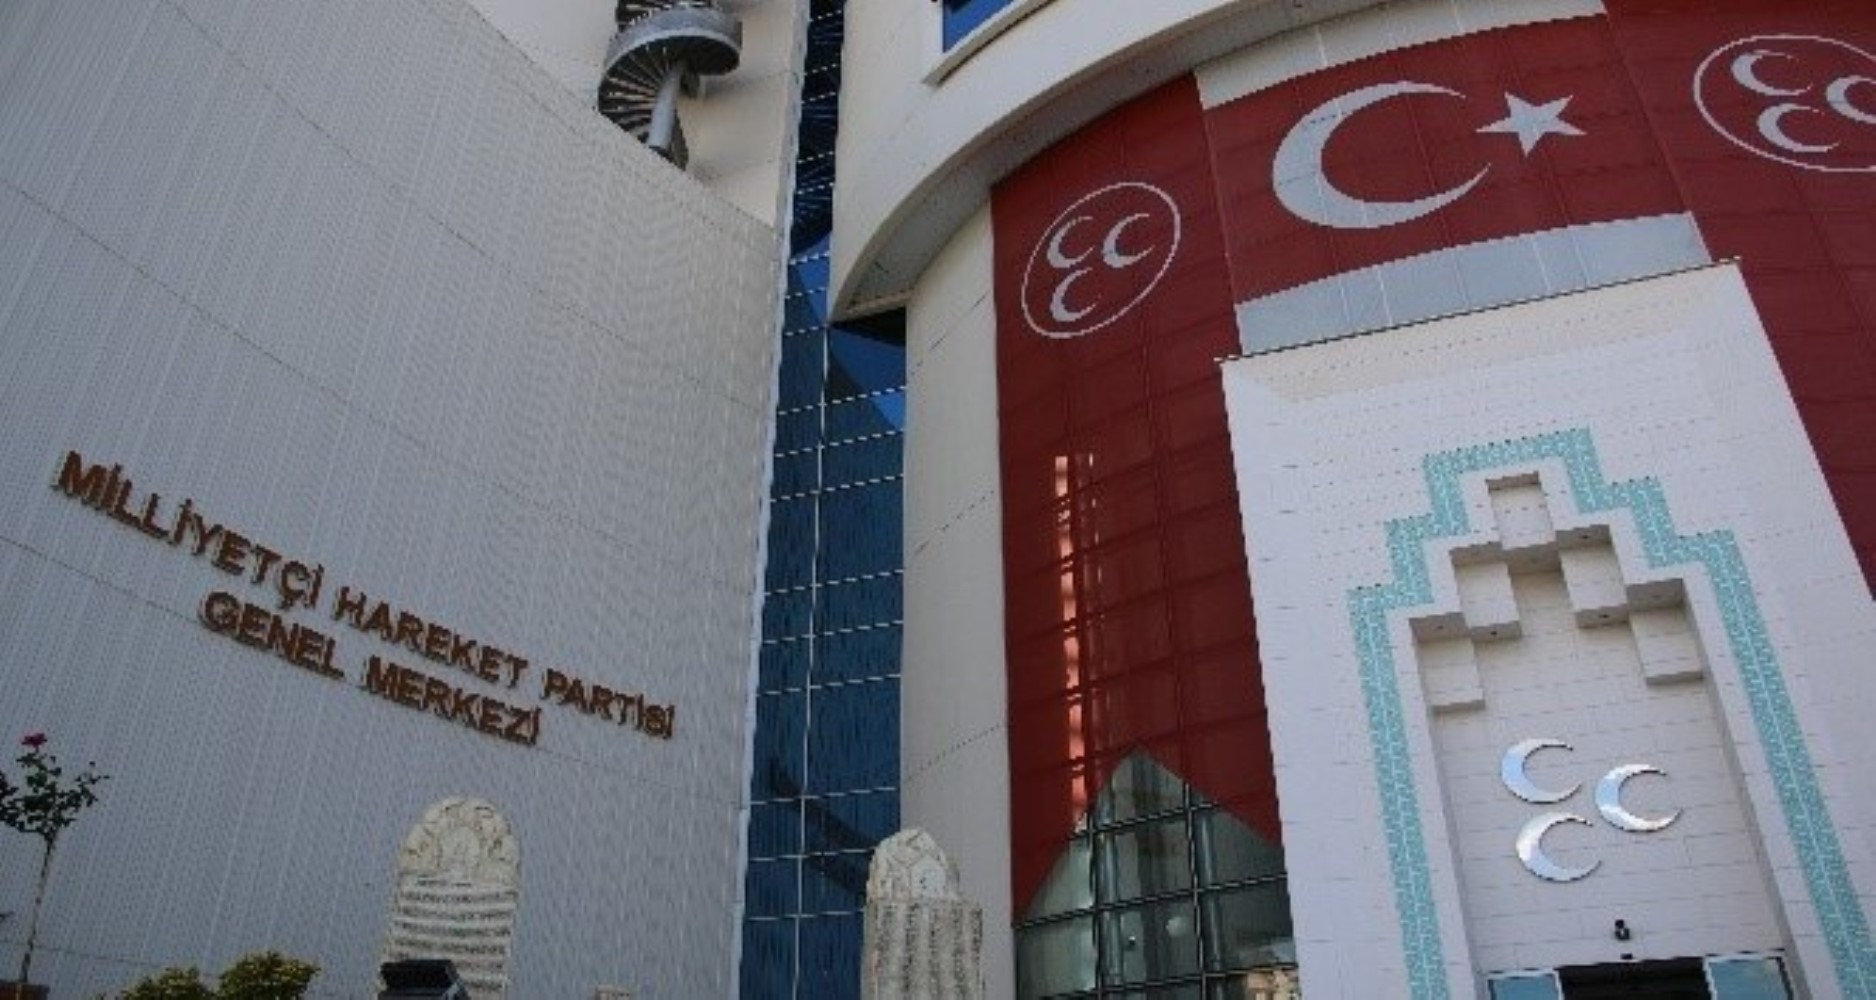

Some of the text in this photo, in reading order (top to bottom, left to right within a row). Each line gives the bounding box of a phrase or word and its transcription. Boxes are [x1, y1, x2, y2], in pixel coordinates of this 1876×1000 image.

[52, 451, 675, 739] MİLLİYETÇİ HAREKET PARTİSİ
[199, 592, 541, 746] GENEL MERKEZİ
